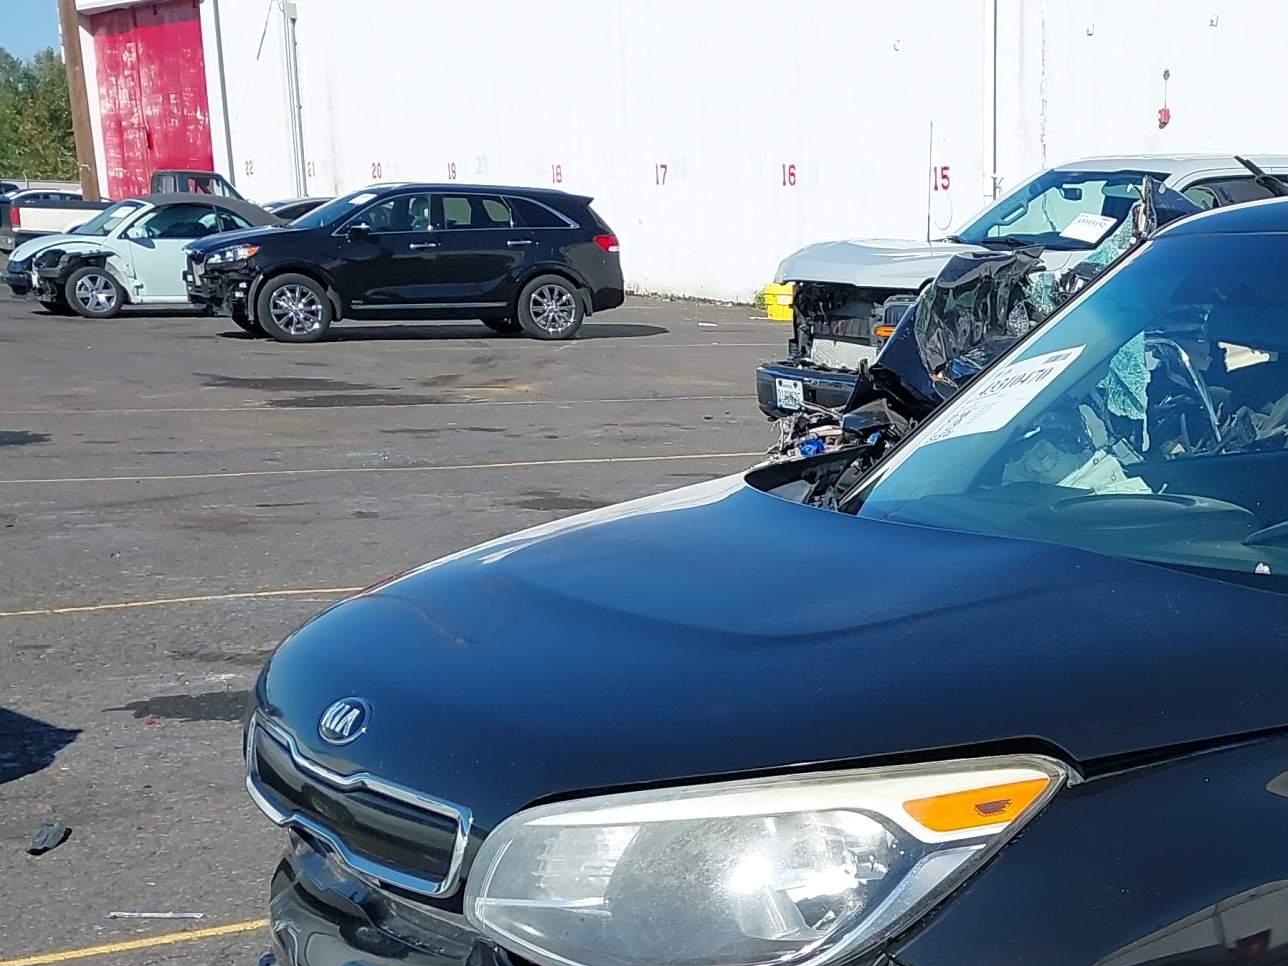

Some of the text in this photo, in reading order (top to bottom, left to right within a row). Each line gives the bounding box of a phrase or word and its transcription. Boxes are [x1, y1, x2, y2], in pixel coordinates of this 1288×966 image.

[371, 162, 382, 179] 20
[447, 162, 457, 180] 19
[552, 164, 563, 184] 18
[655, 163, 668, 185] 17
[782, 163, 797, 187] 16
[933, 166, 951, 191] 15
[321, 700, 361, 737] KIA
